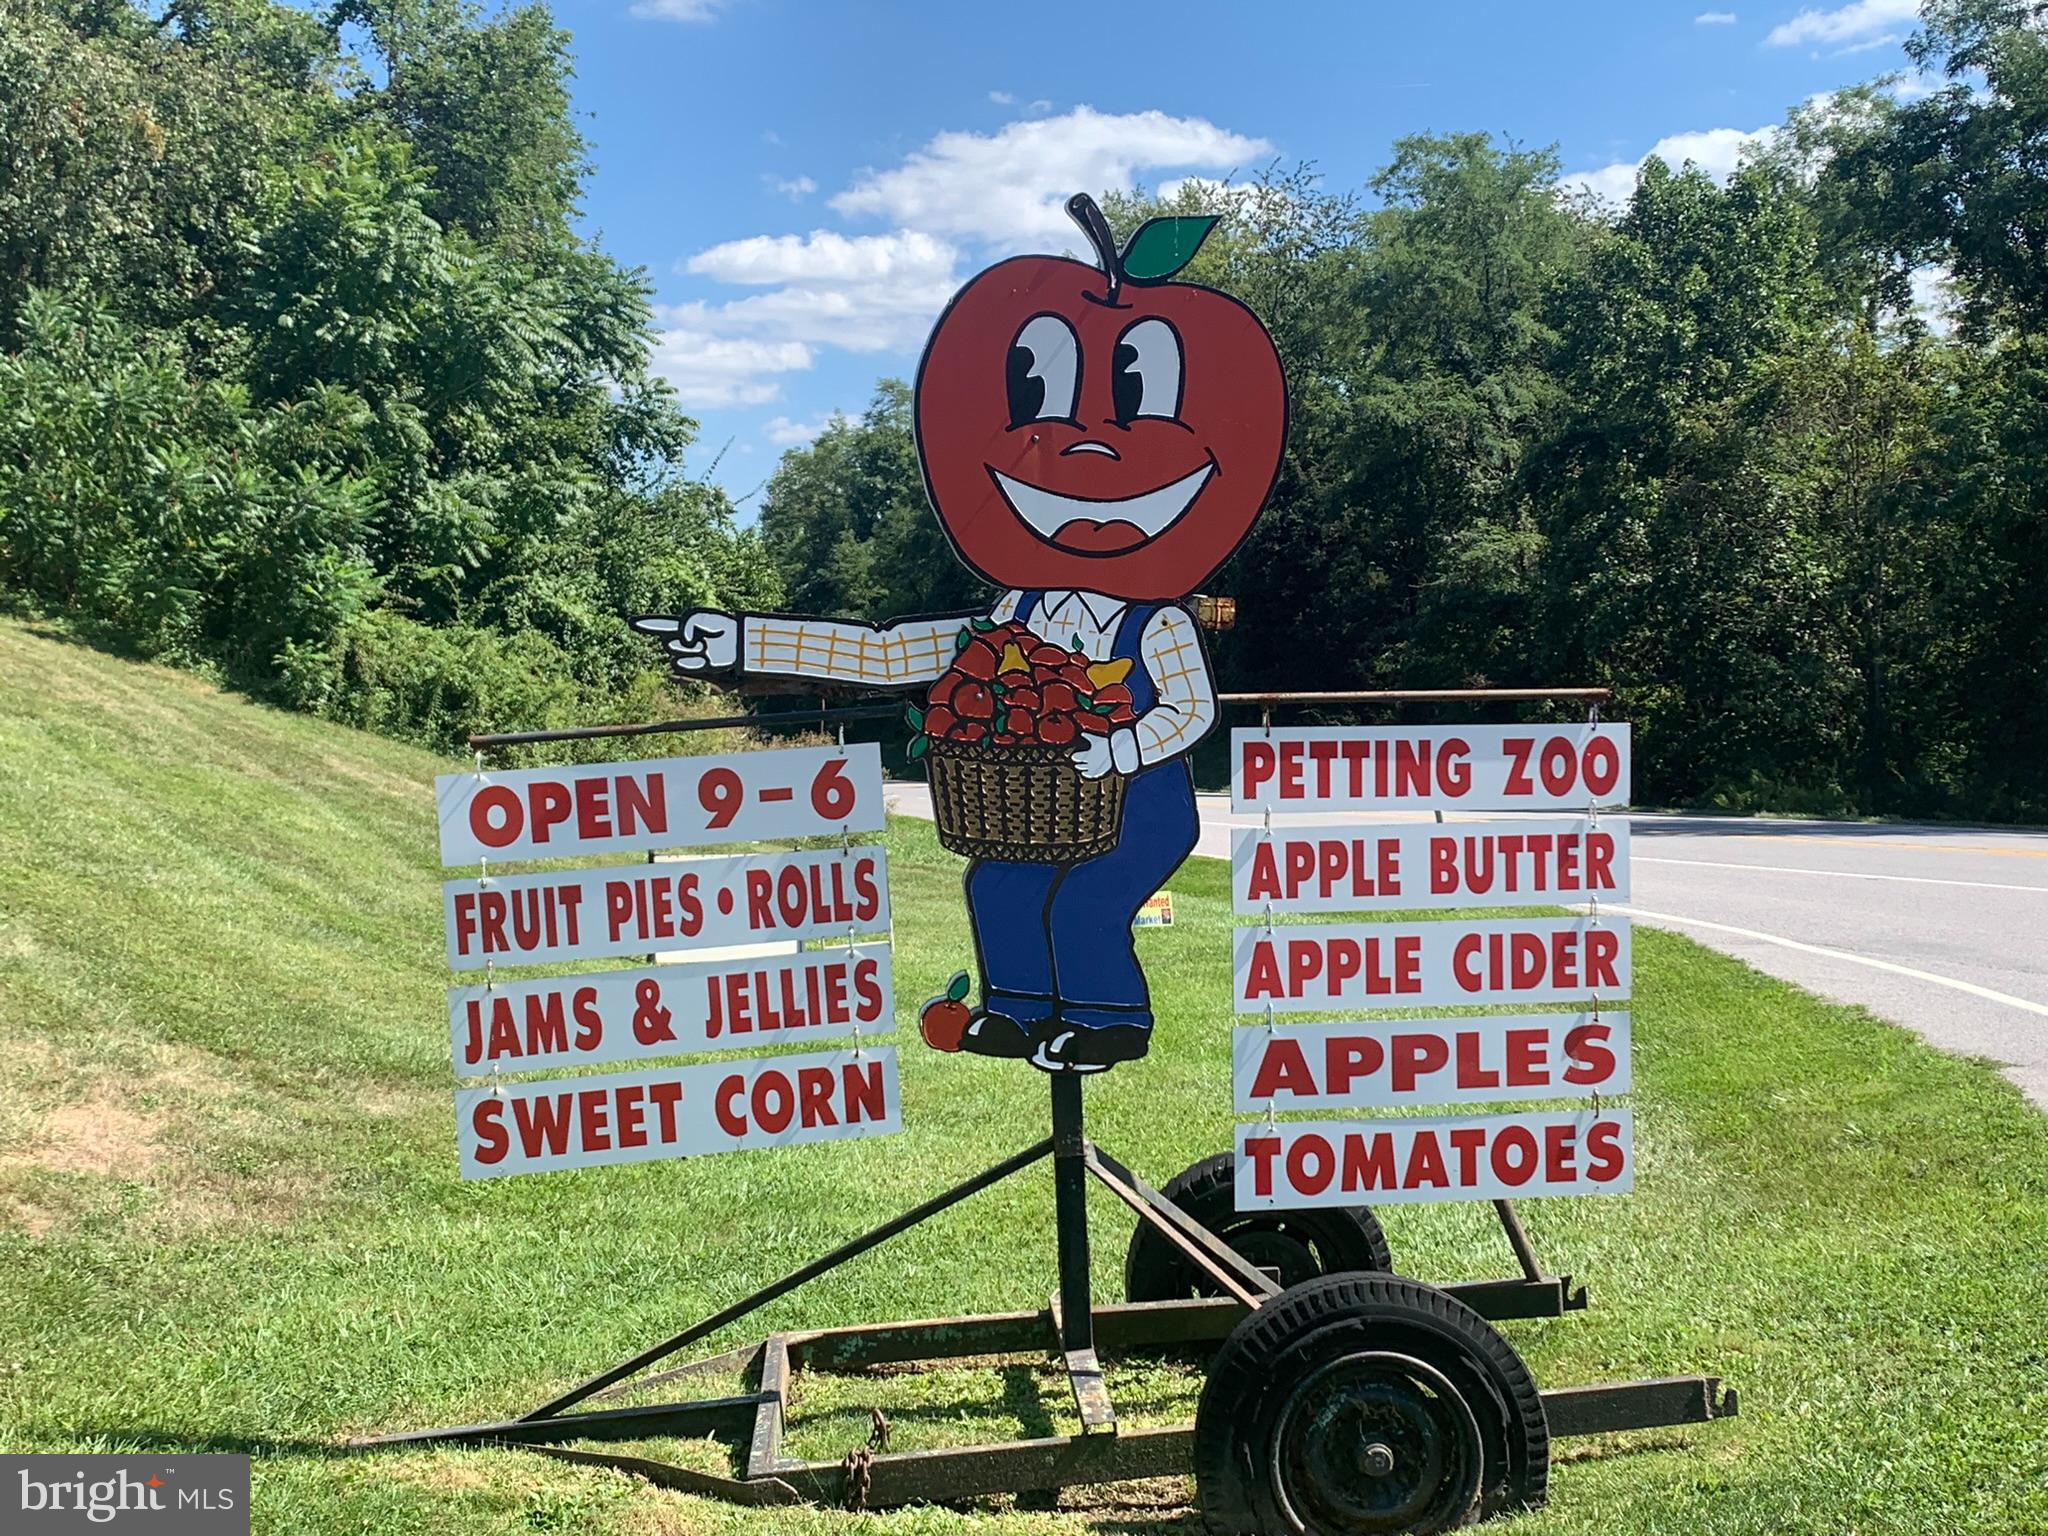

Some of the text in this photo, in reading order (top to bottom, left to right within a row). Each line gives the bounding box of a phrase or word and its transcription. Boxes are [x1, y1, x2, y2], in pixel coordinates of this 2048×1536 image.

[1242, 736, 1619, 799] PETTING ZOO
[469, 773, 668, 847] OPEN
[1248, 833, 1616, 900] APPLE BUTTER
[454, 858, 879, 955] FRUIT PIES ROLLS
[1244, 930, 1620, 999] APPLE CIDER
[465, 959, 882, 1065] JAMS & JELLIES
[1249, 1024, 1616, 1098] APPLES
[472, 1061, 886, 1165] SWEET CORN
[1245, 1122, 1624, 1196] TOMATOES
